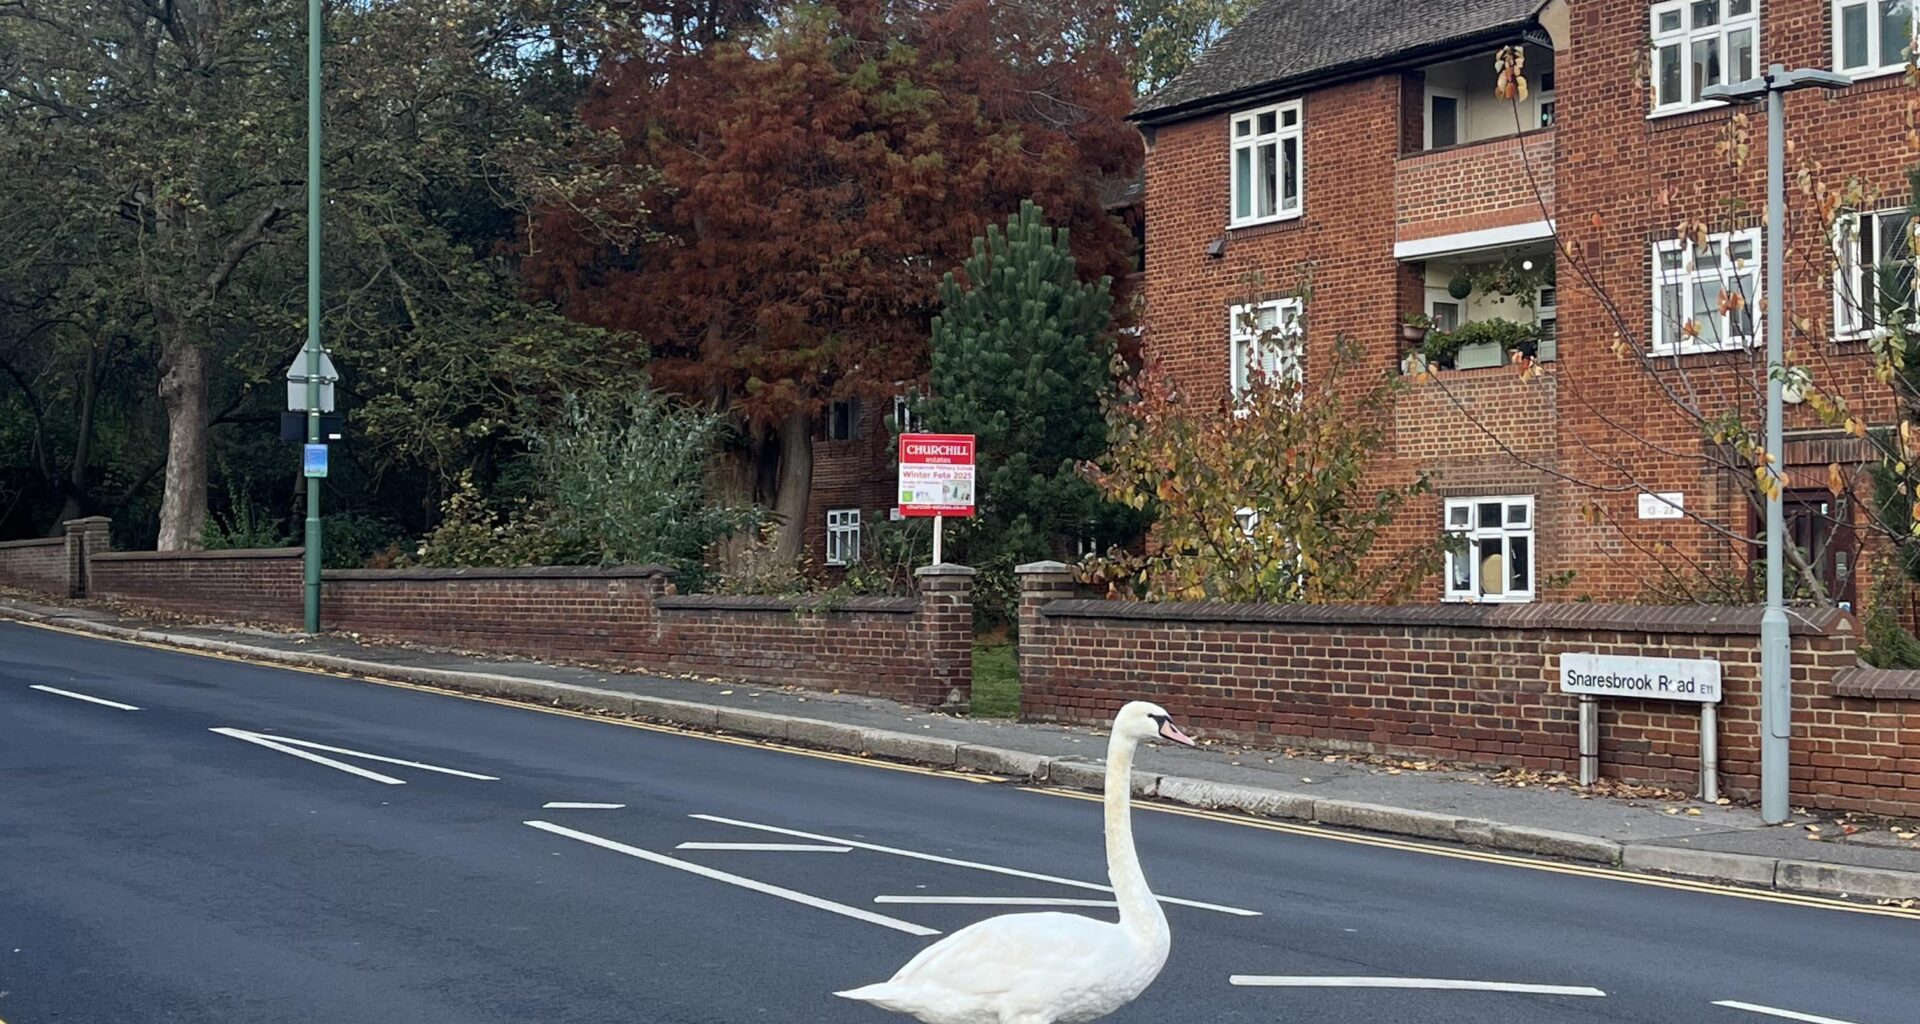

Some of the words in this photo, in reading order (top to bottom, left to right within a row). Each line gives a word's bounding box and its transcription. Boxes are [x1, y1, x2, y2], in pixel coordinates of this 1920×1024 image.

[906, 444, 969, 456] CHURCHILL
[903, 471, 930, 479] Winter
[953, 472, 972, 480] 2025
[1567, 669, 1652, 691] Snaresbrook
[1658, 675, 1695, 694] Rad
[1700, 684, 1714, 695] E11
